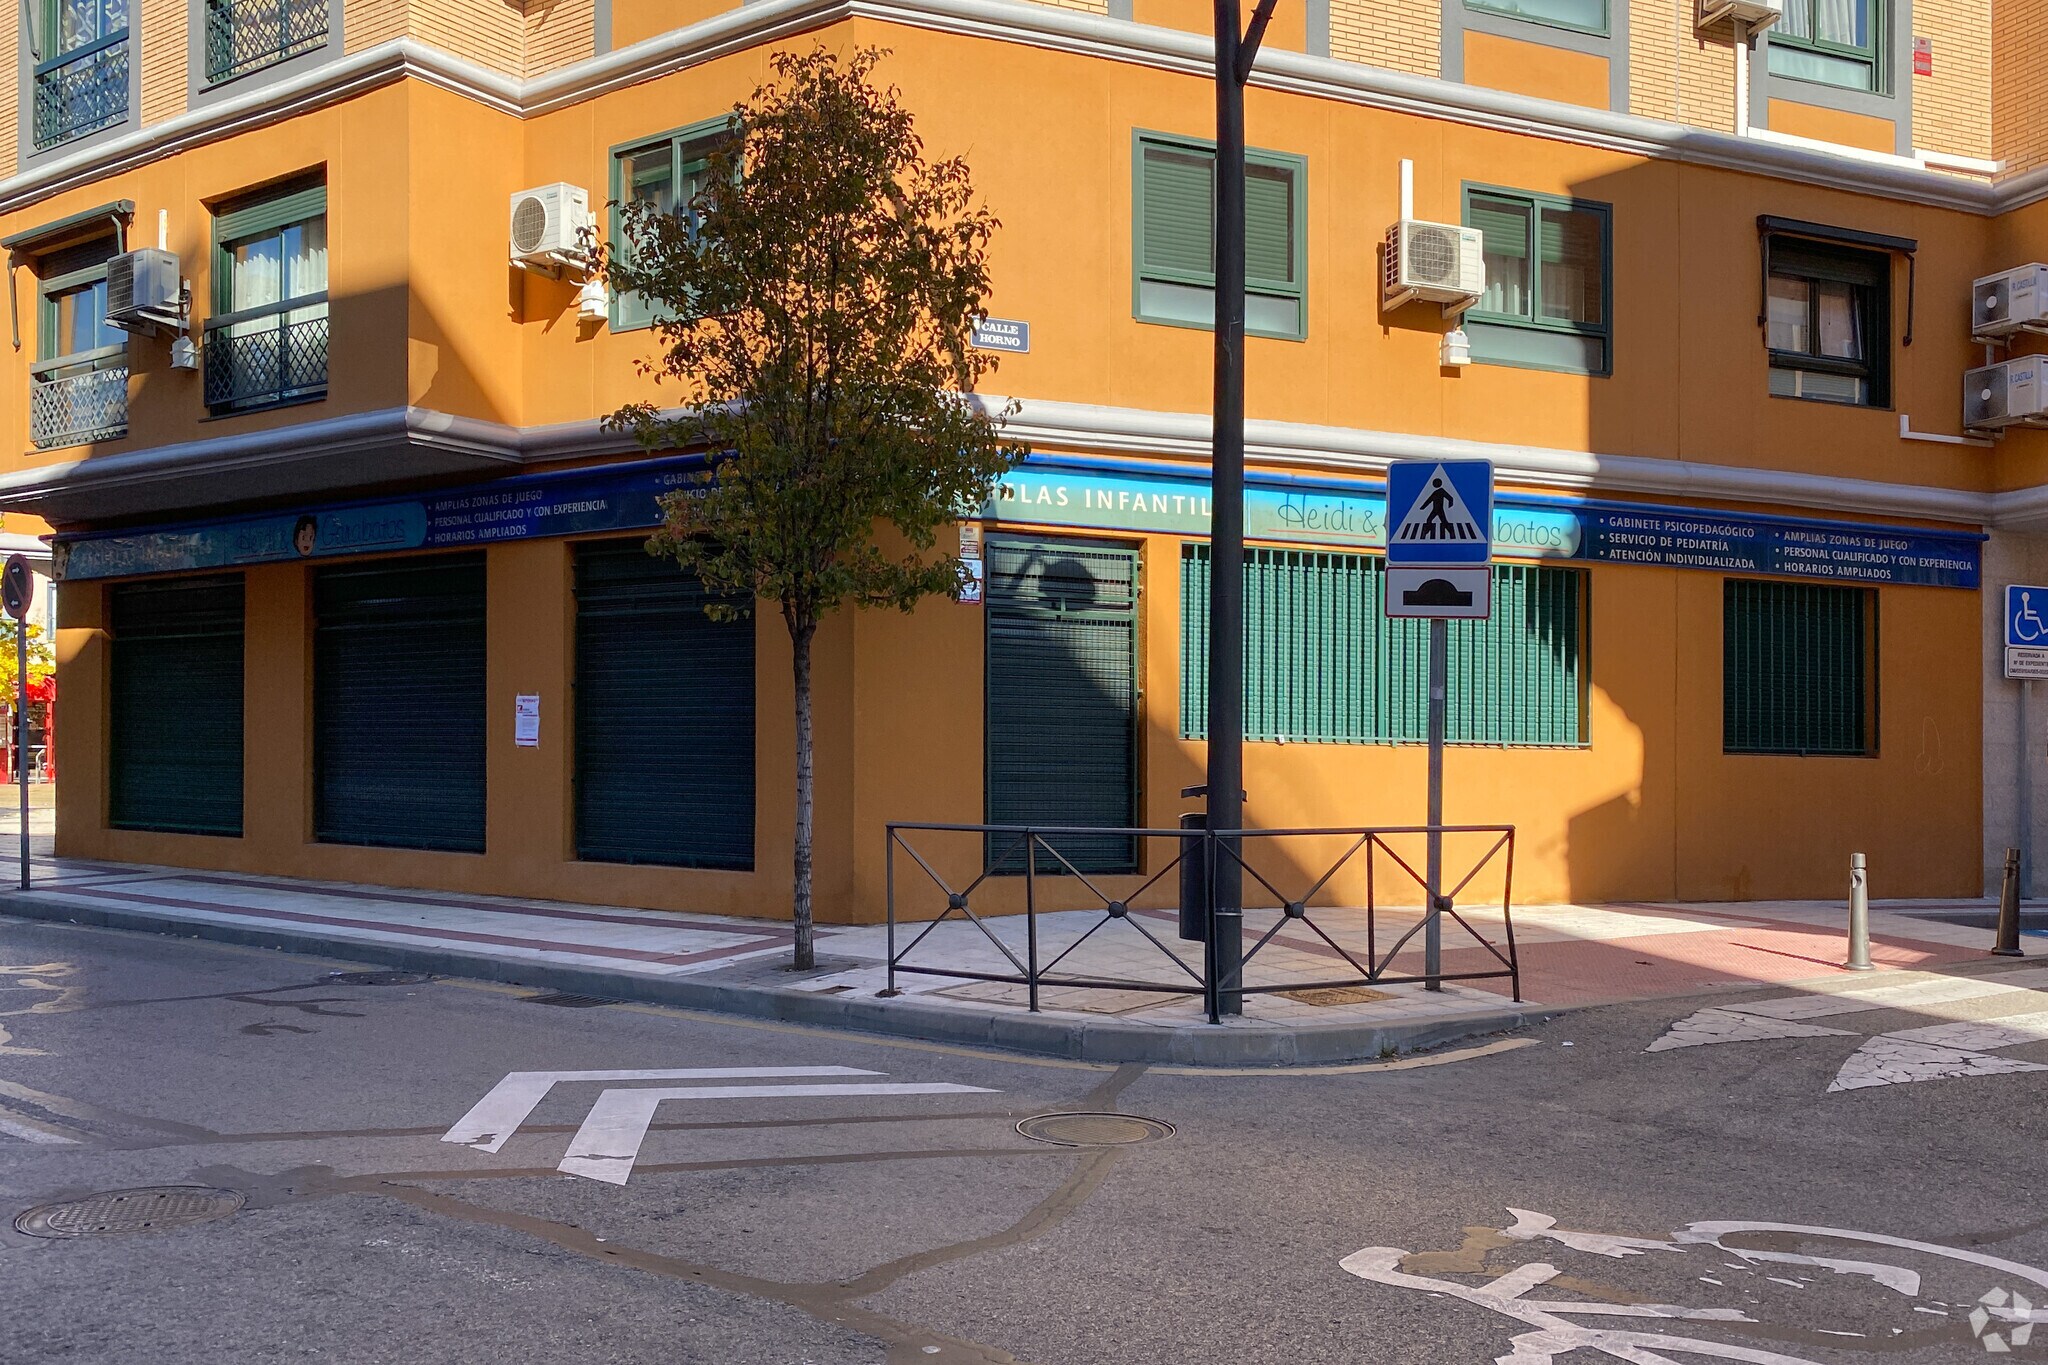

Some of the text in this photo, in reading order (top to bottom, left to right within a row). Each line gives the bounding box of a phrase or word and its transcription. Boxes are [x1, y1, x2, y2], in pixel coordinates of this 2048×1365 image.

[981, 322, 1019, 335] CALLE
[979, 333, 1021, 347] HORNO
[435, 489, 543, 512] AMPLIAS ZONAS DE JUEGO
[1085, 488, 1212, 517] INFANTIL
[434, 499, 607, 528] PERSONAL CUALIFICADO Y CON EXPERIENCIA
[1277, 493, 1354, 532] Heidi
[1363, 509, 1378, 536] &
[434, 524, 527, 544] HORARIOS AMPLIADOS
[1609, 516, 1755, 538] GABINETE PSICOPEDAGÓGICO
[1609, 532, 1729, 552] SERVICIO DE PEDIATRÍA
[1784, 531, 1908, 551] AMPLIAS ZONAS DE JUEGO
[1609, 548, 1755, 570] ATENCIÓN INDIVIDUALIZADA
[1784, 546, 1973, 571] PERSONAL CUALIFICADO Y CON EXPERIENCIA
[1784, 562, 1892, 580] HORARIOS AMPLIADOS
